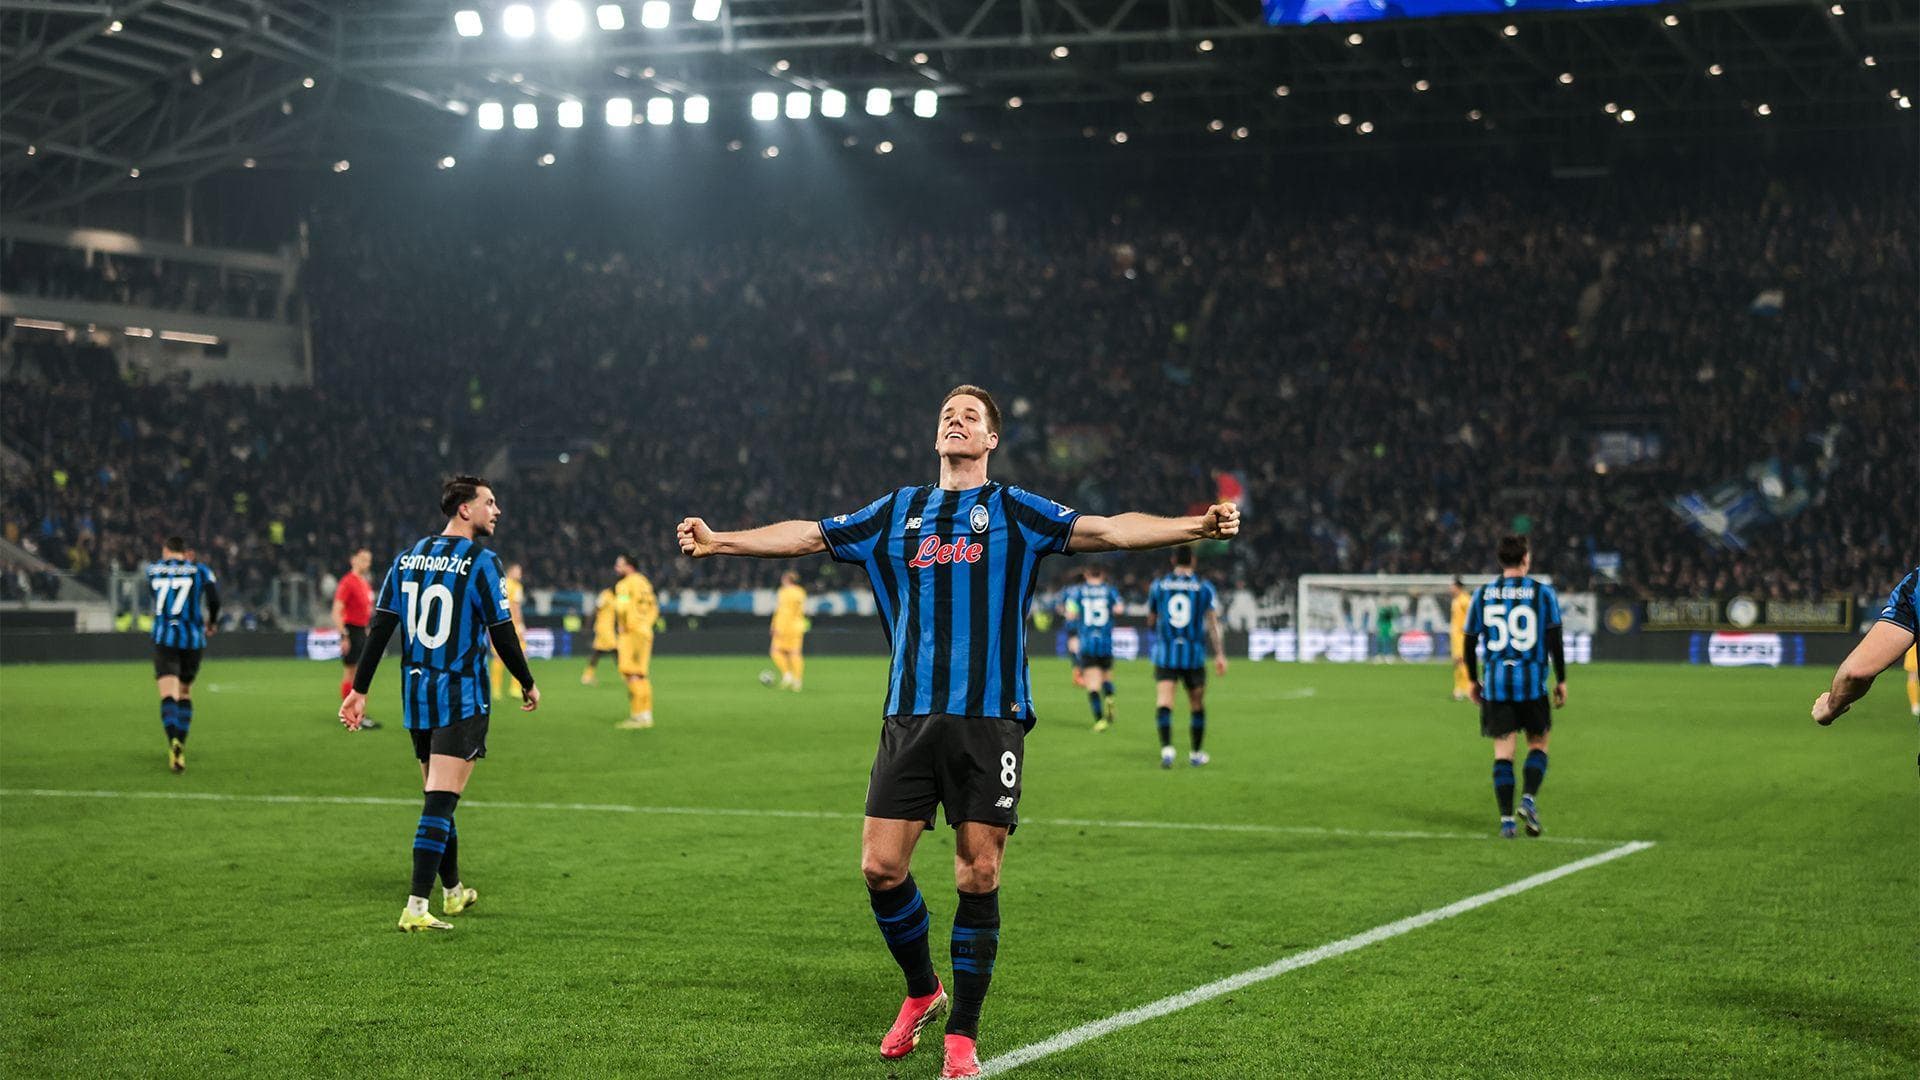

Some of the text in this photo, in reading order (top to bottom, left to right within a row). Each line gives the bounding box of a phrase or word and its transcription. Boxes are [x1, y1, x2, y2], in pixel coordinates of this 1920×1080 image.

[399, 554, 472, 576] SAMARDŽIĆ
[909, 534, 984, 568] Lete
[152, 577, 193, 616] 77
[1167, 593, 1191, 628] 9
[401, 581, 454, 650] 10
[1483, 604, 1537, 652] 59
[1248, 631, 1369, 662] PEPSI
[1000, 750, 1017, 788] 8
